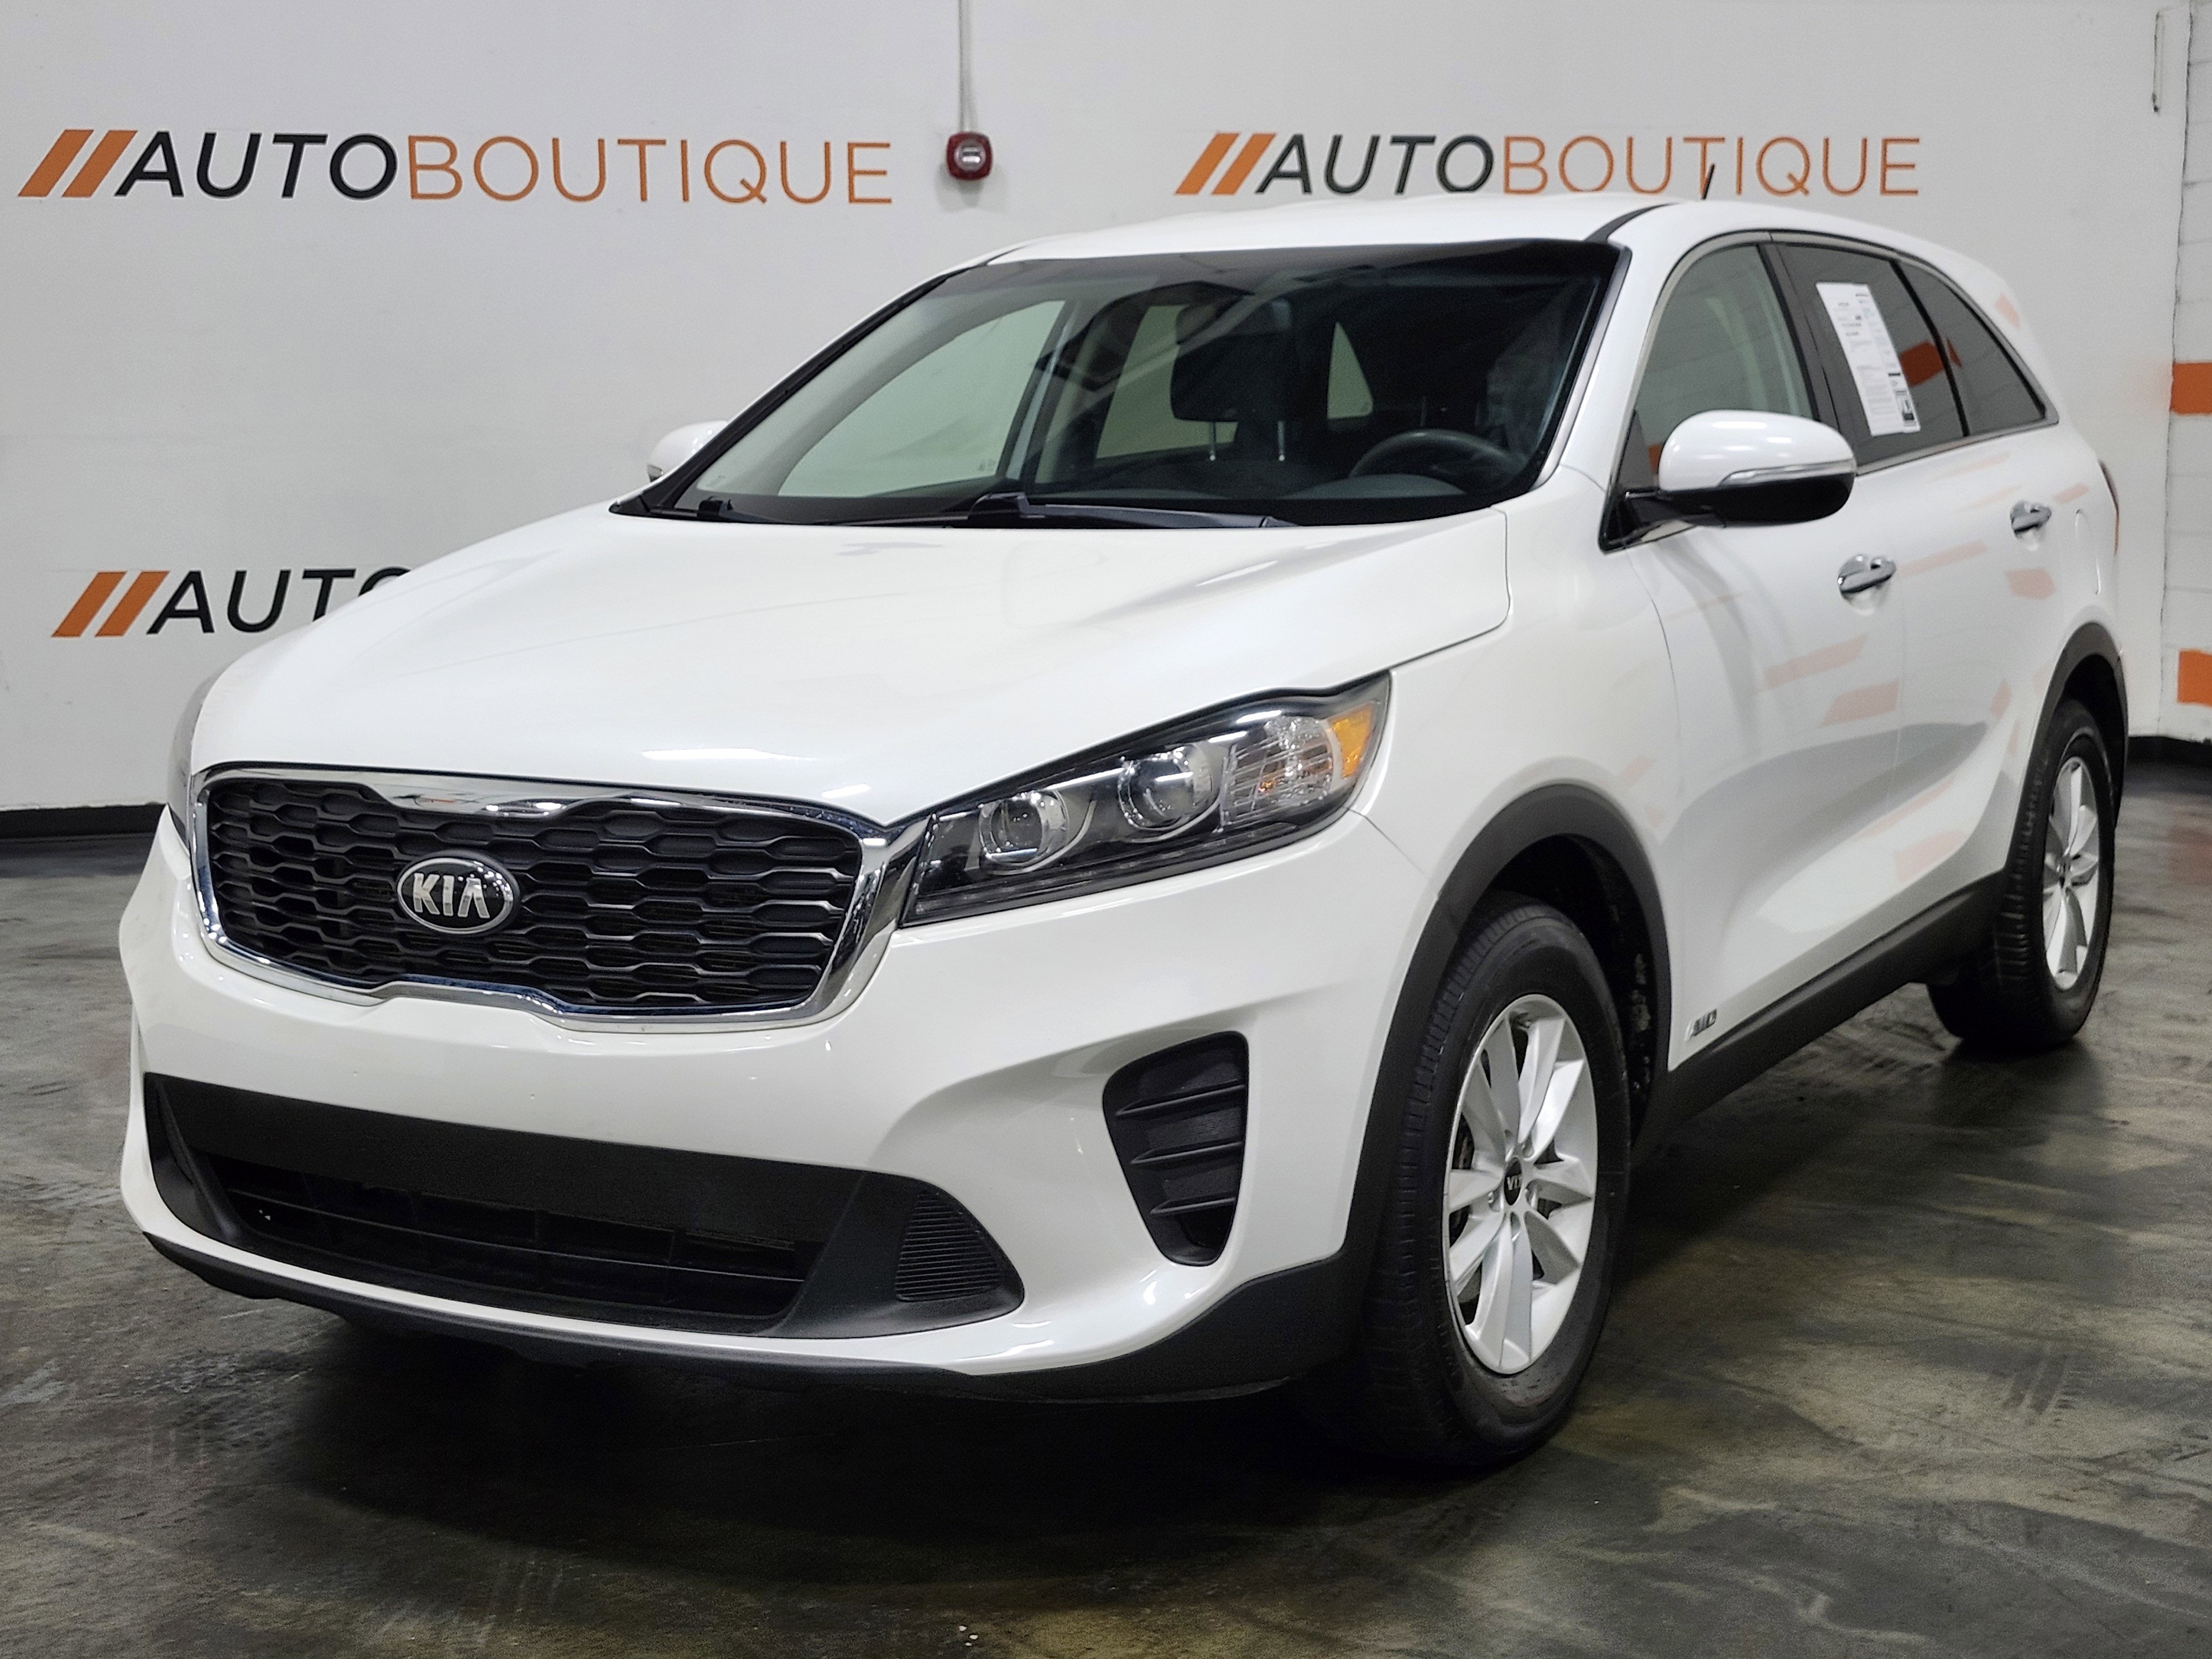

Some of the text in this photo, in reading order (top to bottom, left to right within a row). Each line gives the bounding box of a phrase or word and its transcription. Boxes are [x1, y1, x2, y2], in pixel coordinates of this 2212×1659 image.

[114, 130, 892, 205] AUTOBOUTIQUE
[1255, 134, 1920, 196] AUTOBOUTIQUE
[145, 567, 412, 635] AUT
[413, 873, 491, 919] KIA
